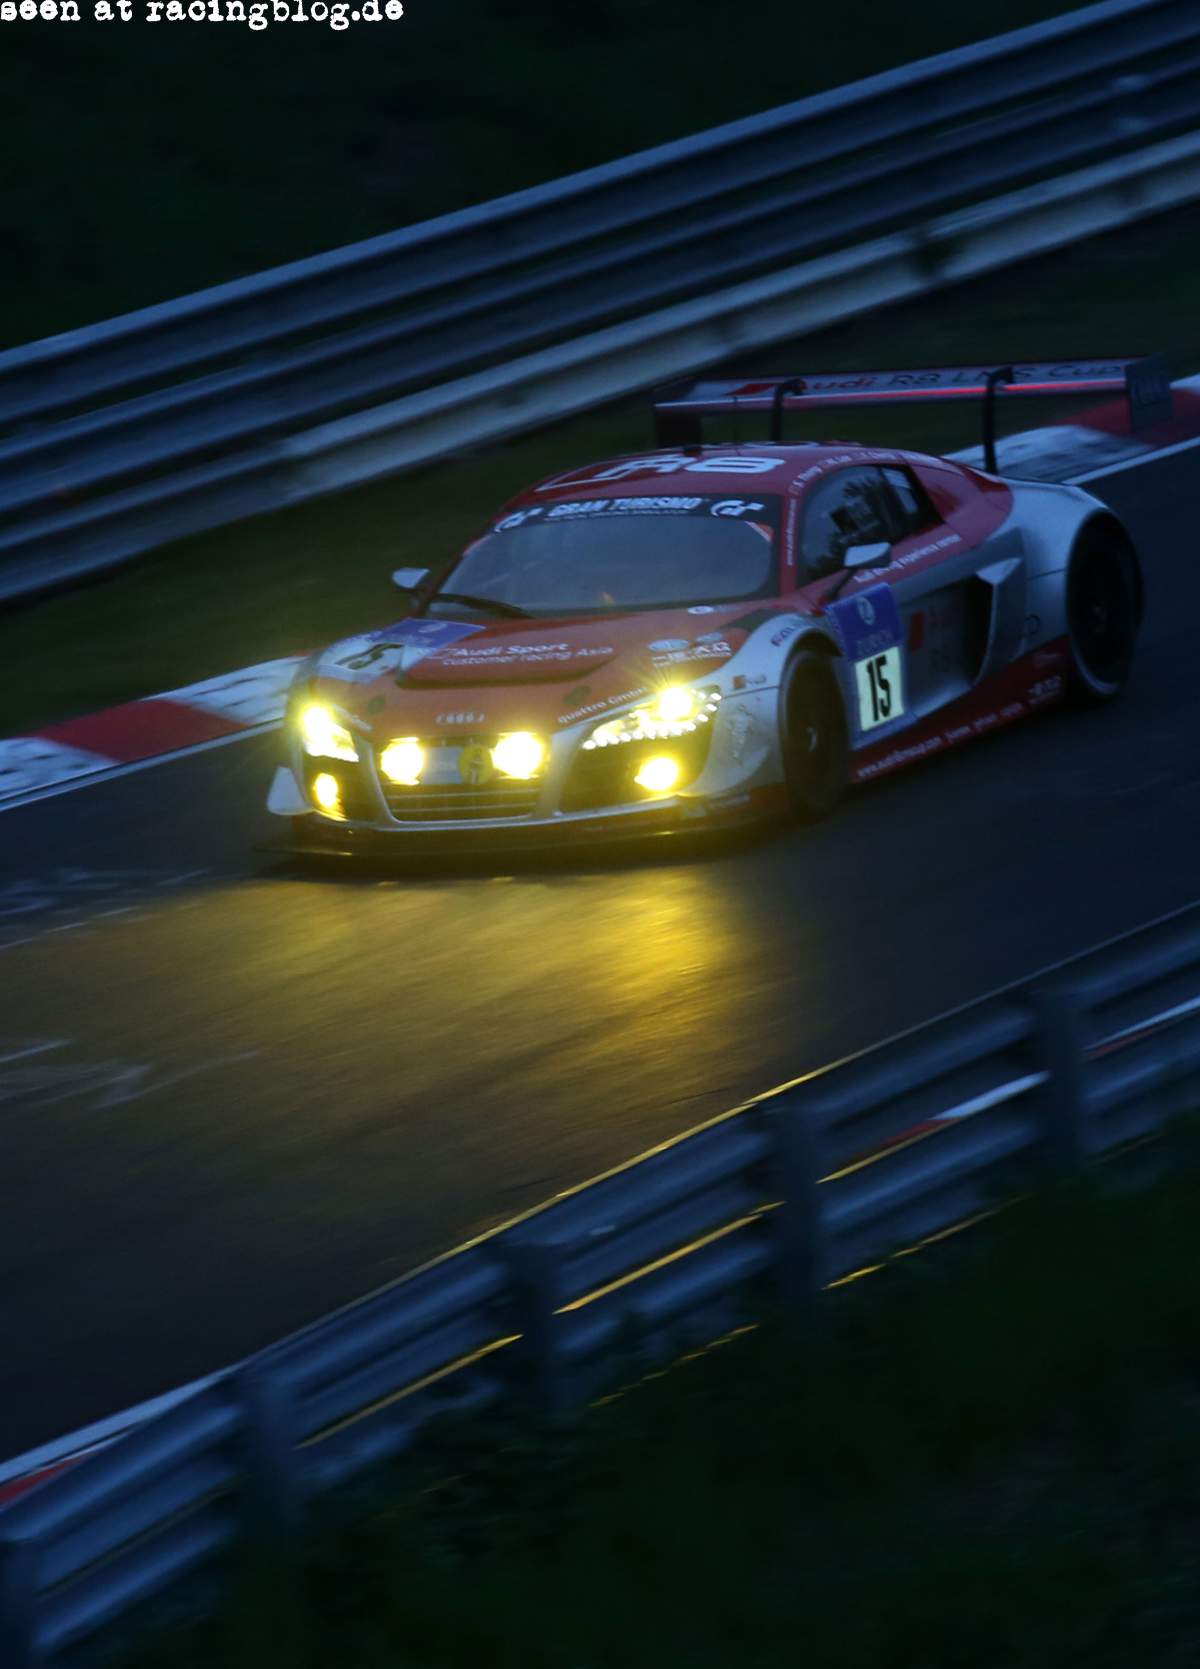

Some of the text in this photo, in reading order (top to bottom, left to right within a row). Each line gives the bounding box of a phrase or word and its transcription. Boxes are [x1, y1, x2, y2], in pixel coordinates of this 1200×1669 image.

[795, 375, 878, 391] udi
[888, 373, 941, 387] R8
[1047, 363, 1123, 379] Cup
[592, 454, 786, 479] R8
[506, 642, 569, 655] Sport
[866, 654, 892, 723] 15
[557, 699, 607, 725] quattro
